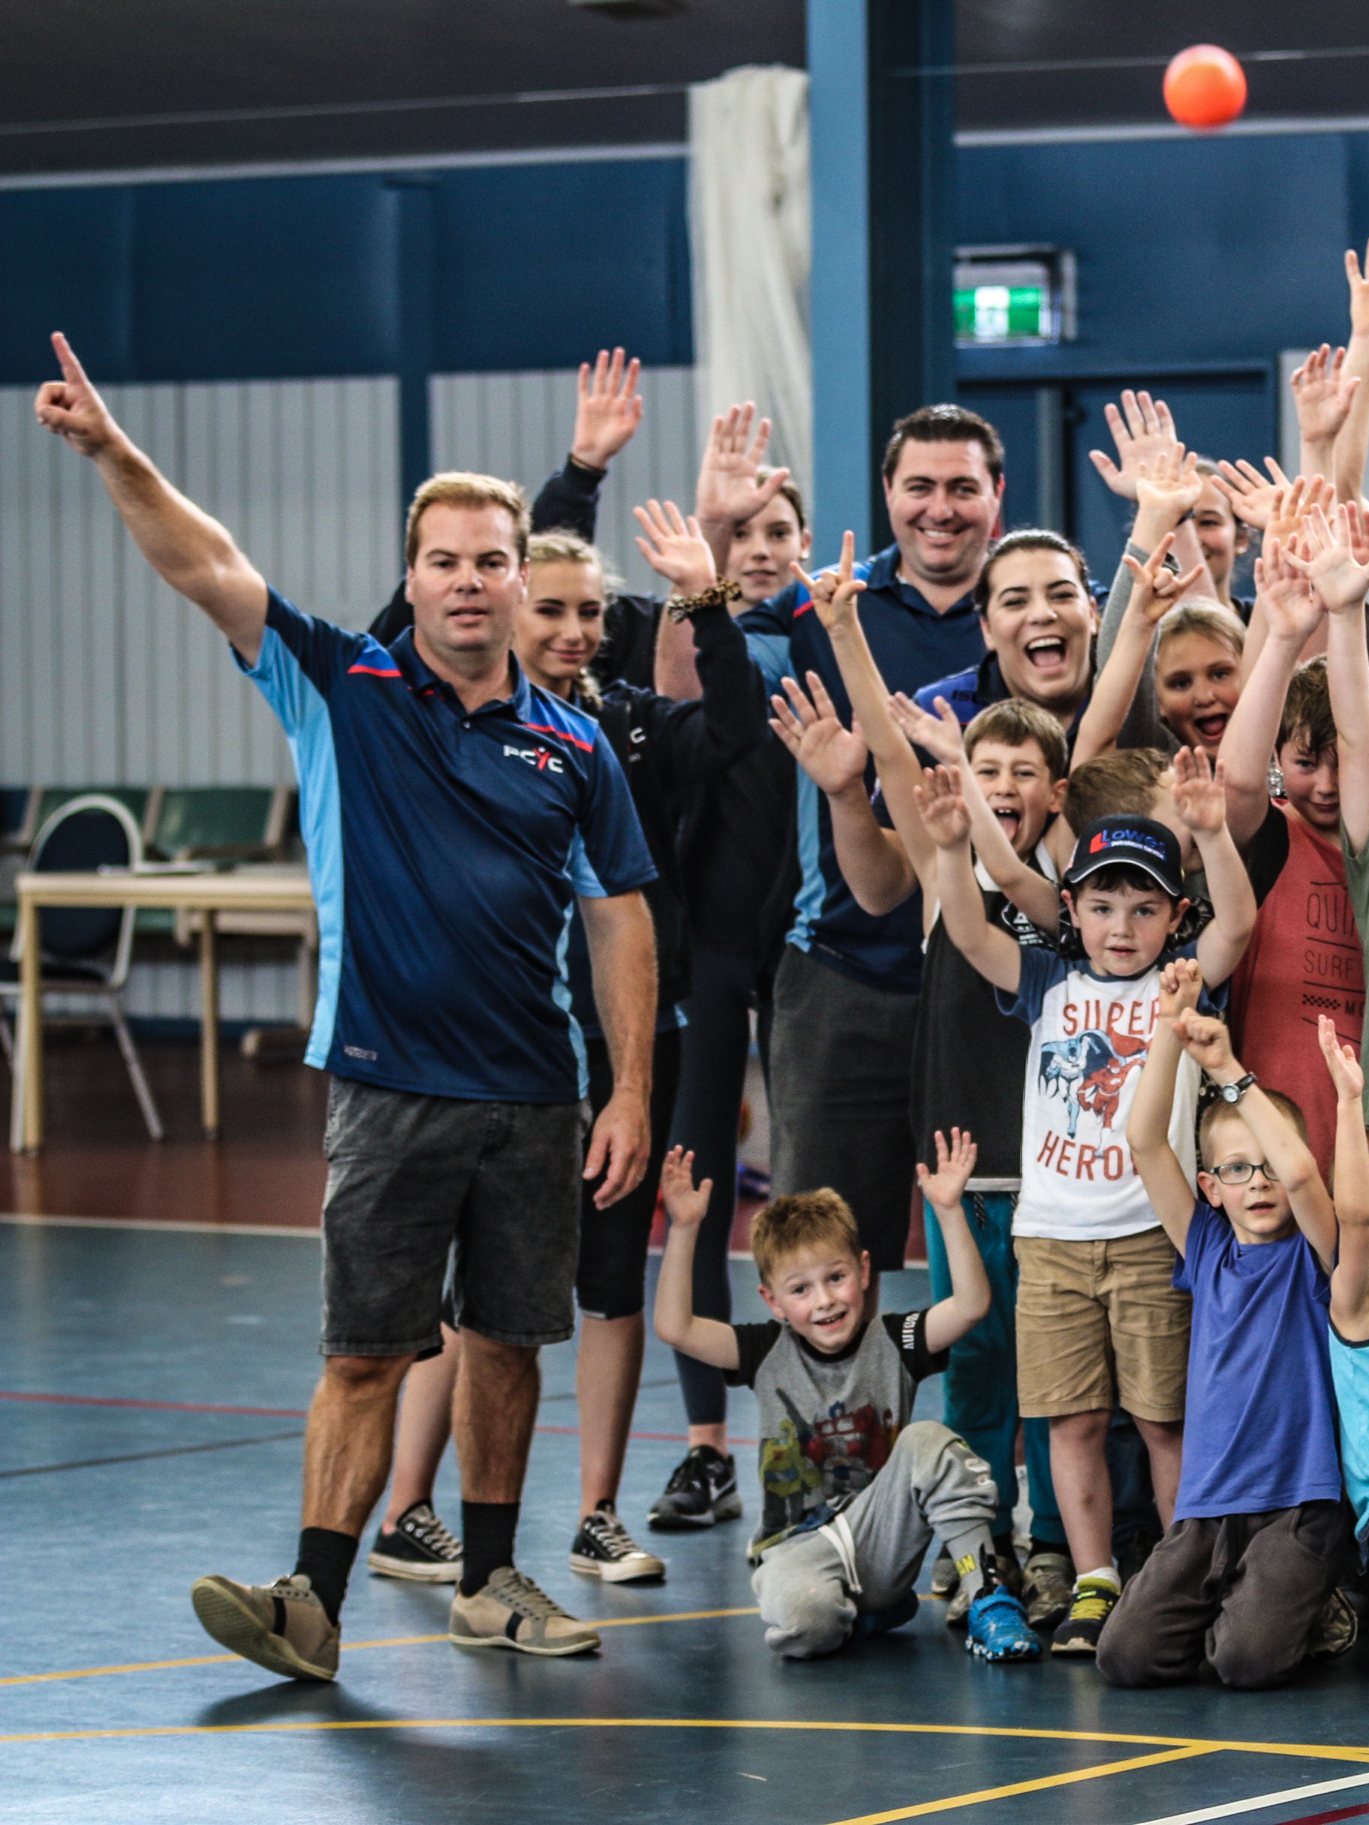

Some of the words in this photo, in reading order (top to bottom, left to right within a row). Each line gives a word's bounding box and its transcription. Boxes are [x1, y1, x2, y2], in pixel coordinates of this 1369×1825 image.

[503, 744, 564, 774] PCYC
[1304, 950, 1354, 990] SURF
[1037, 1130, 1139, 1181] HERO
